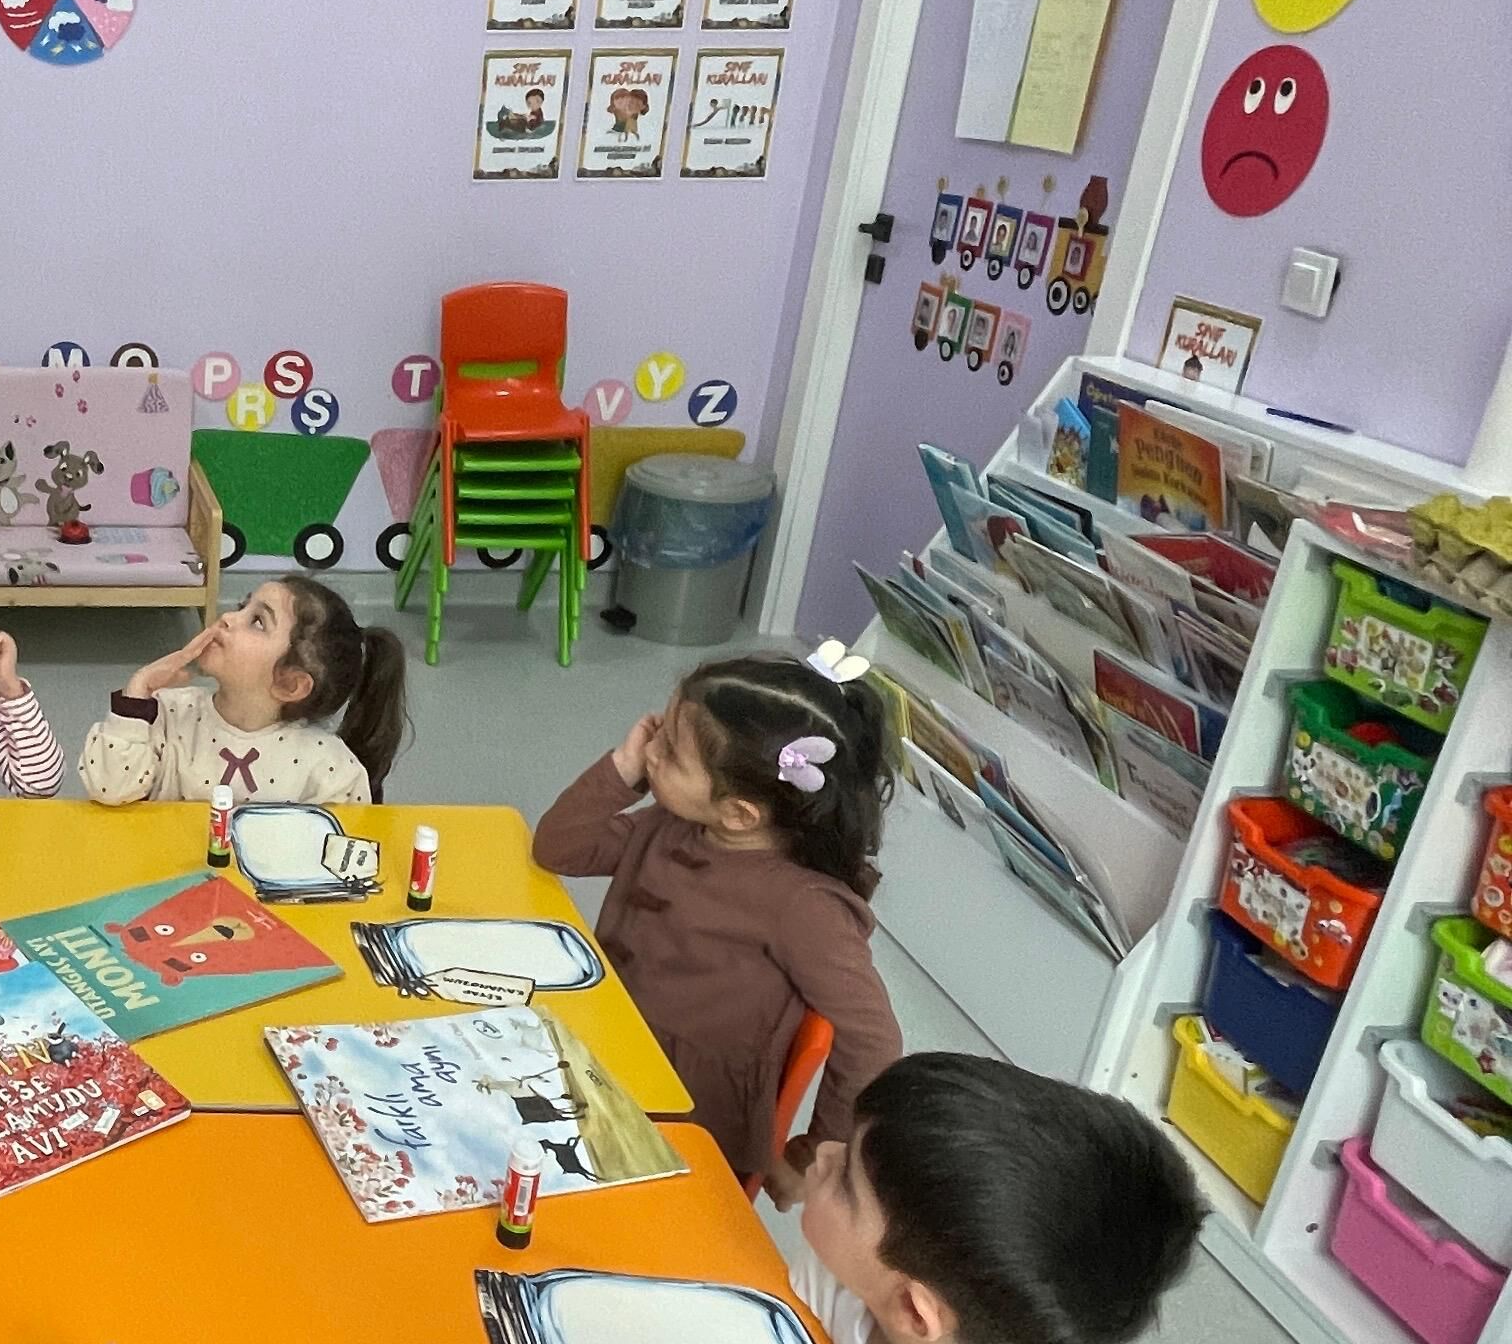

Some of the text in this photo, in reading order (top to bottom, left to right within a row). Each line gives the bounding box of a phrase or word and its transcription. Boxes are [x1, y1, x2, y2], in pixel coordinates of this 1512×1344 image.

[203, 358, 233, 395] P
[271, 355, 305, 393] S
[401, 362, 432, 397] T
[646, 361, 676, 398] Y
[236, 387, 267, 425] R
[300, 390, 334, 435] Ş
[595, 387, 625, 421] V
[695, 385, 729, 423] Z
[45, 925, 161, 1011] MONTİ
[46, 957, 117, 1020] UTANGAÇ
[421, 1044, 462, 1085] aynı
[400, 1061, 444, 1107] ama
[10, 1127, 69, 1165] AVI
